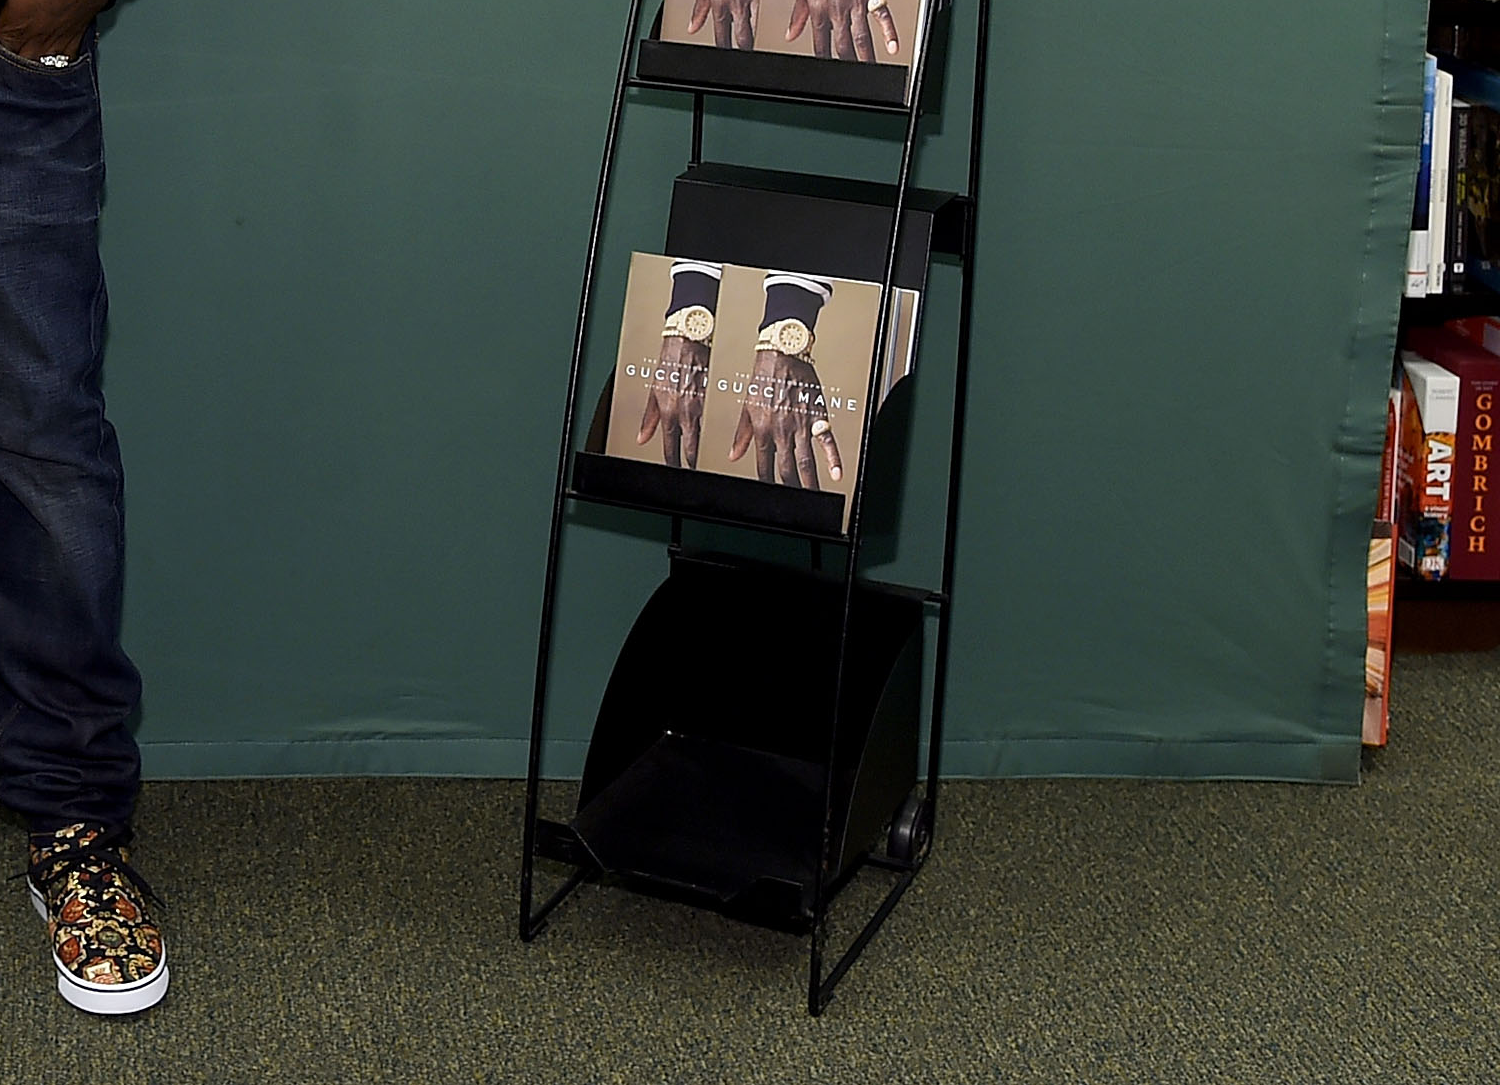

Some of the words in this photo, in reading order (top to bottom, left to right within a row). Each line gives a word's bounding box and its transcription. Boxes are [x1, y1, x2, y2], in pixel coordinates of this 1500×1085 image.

[626, 364, 690, 384] GUCCI
[717, 379, 784, 400] GUCCI
[798, 391, 857, 411] MANE
[1425, 439, 1452, 501] ART
[1467, 393, 1493, 552] GOMBRICH
